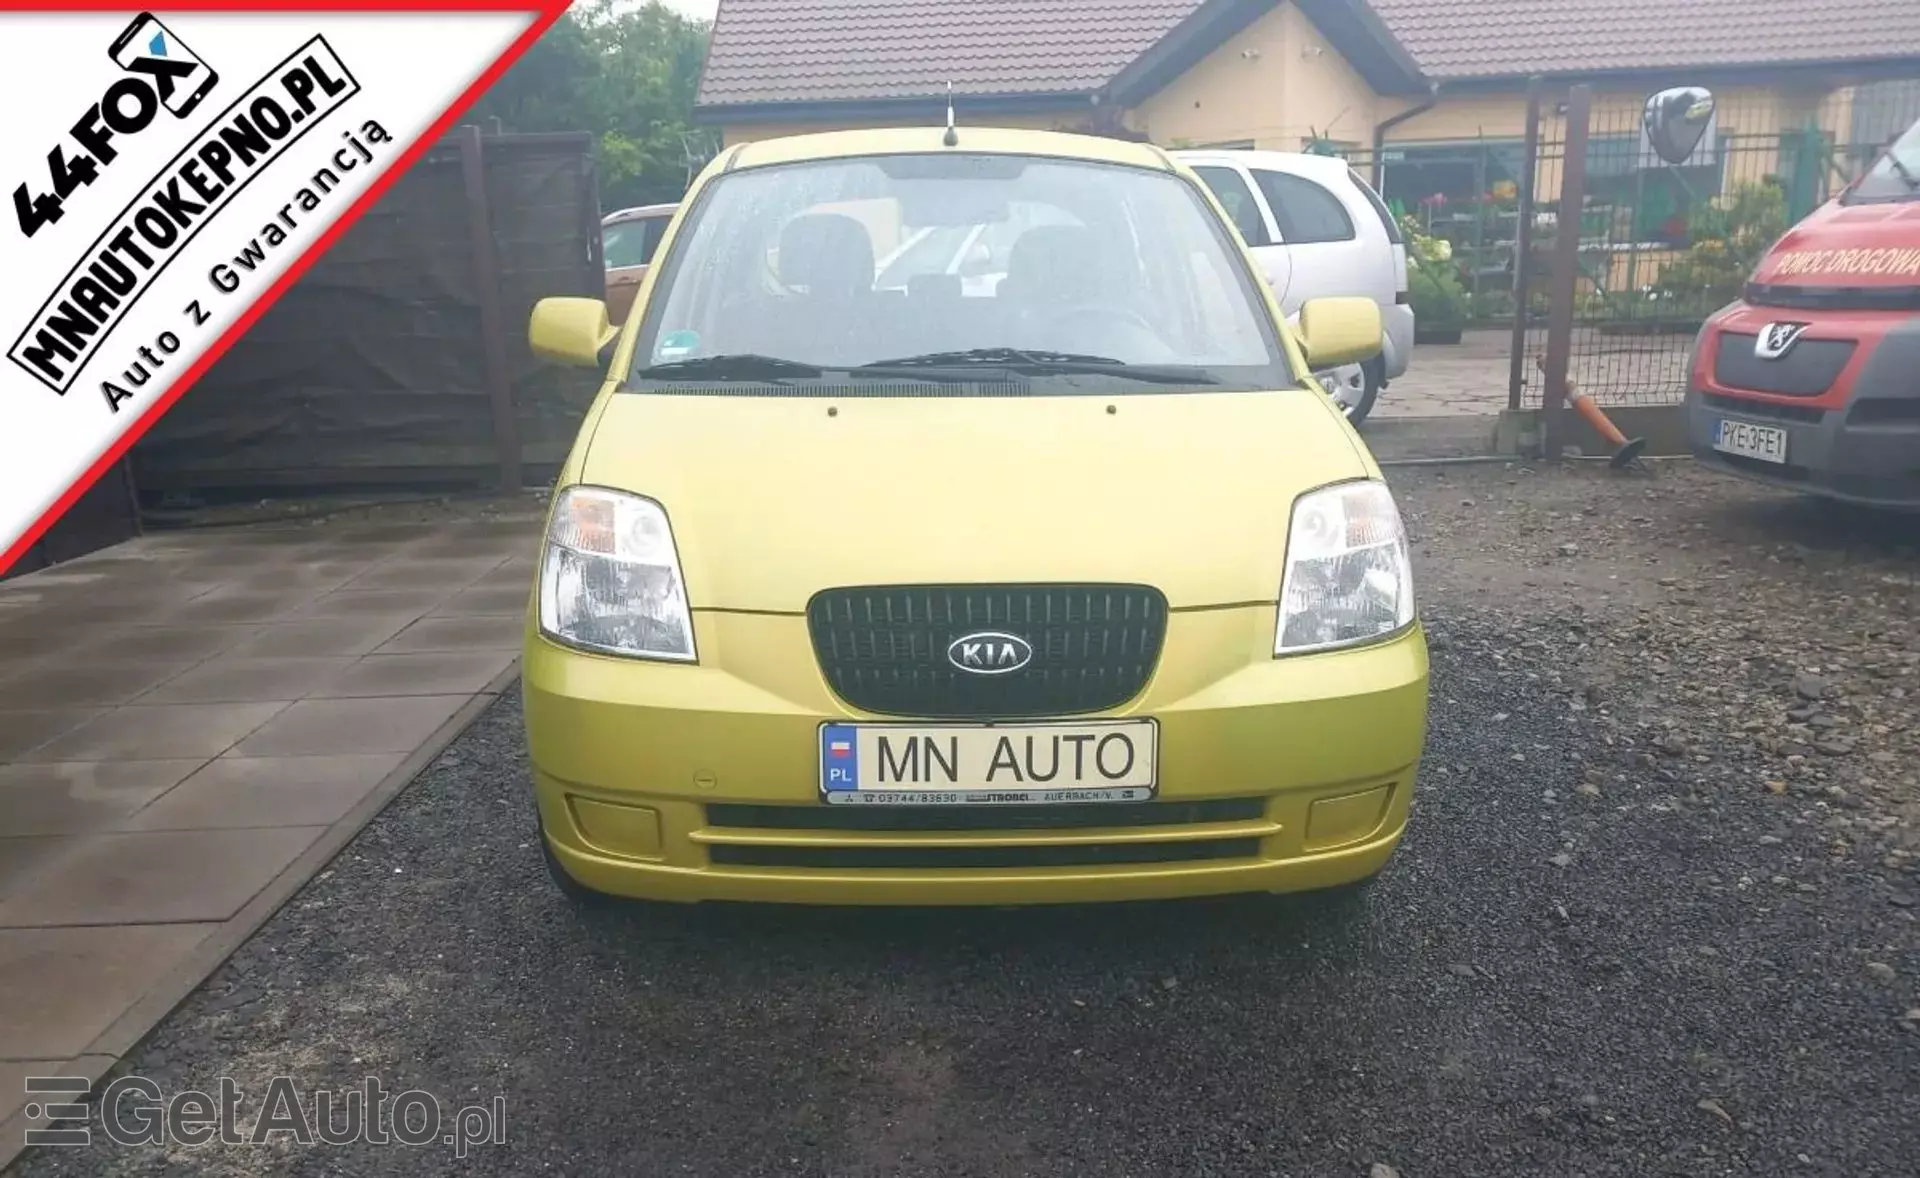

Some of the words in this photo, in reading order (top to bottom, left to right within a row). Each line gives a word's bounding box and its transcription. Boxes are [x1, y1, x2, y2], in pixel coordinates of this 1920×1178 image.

[1772, 249, 1833, 274] POMOC
[1823, 247, 1920, 276] DROGOWA
[961, 643, 1019, 665] KIA
[877, 735, 958, 783] MN
[985, 732, 1135, 783] AUTO
[830, 768, 852, 783] PL
